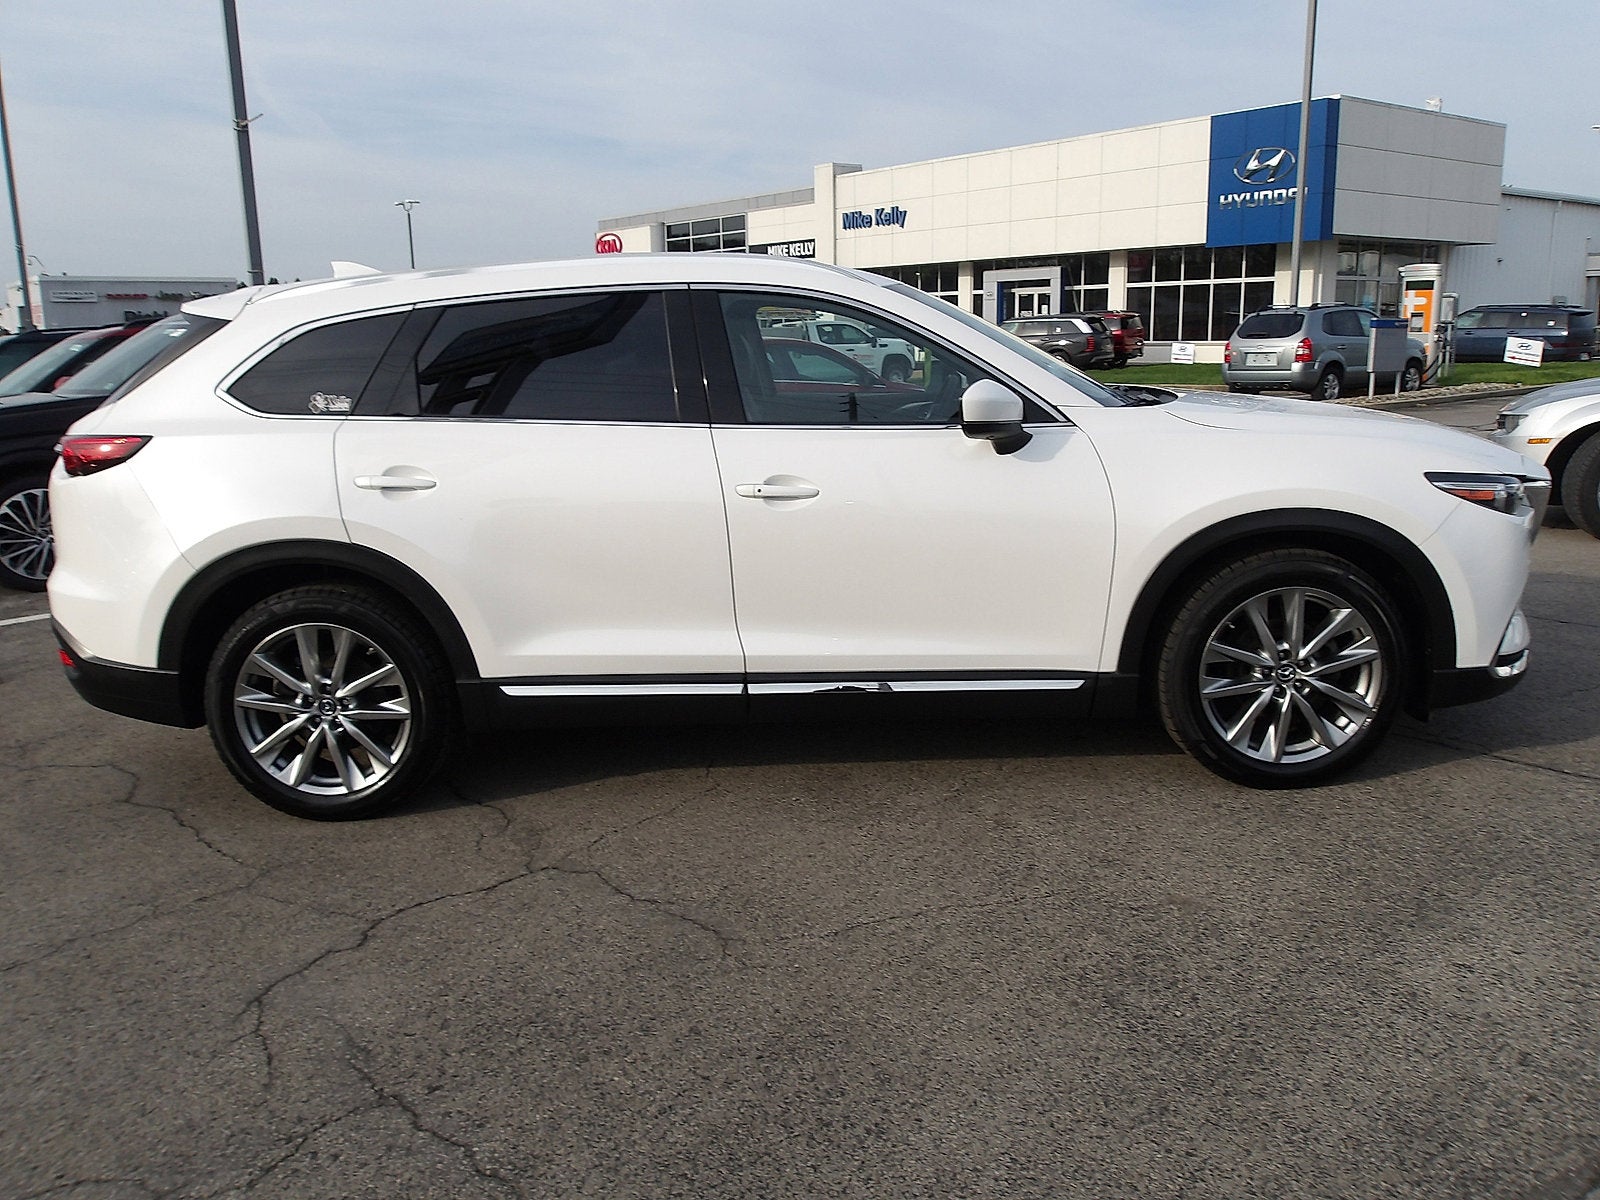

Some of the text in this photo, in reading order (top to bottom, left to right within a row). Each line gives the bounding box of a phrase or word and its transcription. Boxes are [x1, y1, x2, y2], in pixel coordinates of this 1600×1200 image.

[842, 206, 907, 230] Mike Kelly
[767, 242, 815, 256] MIKE KELLY
